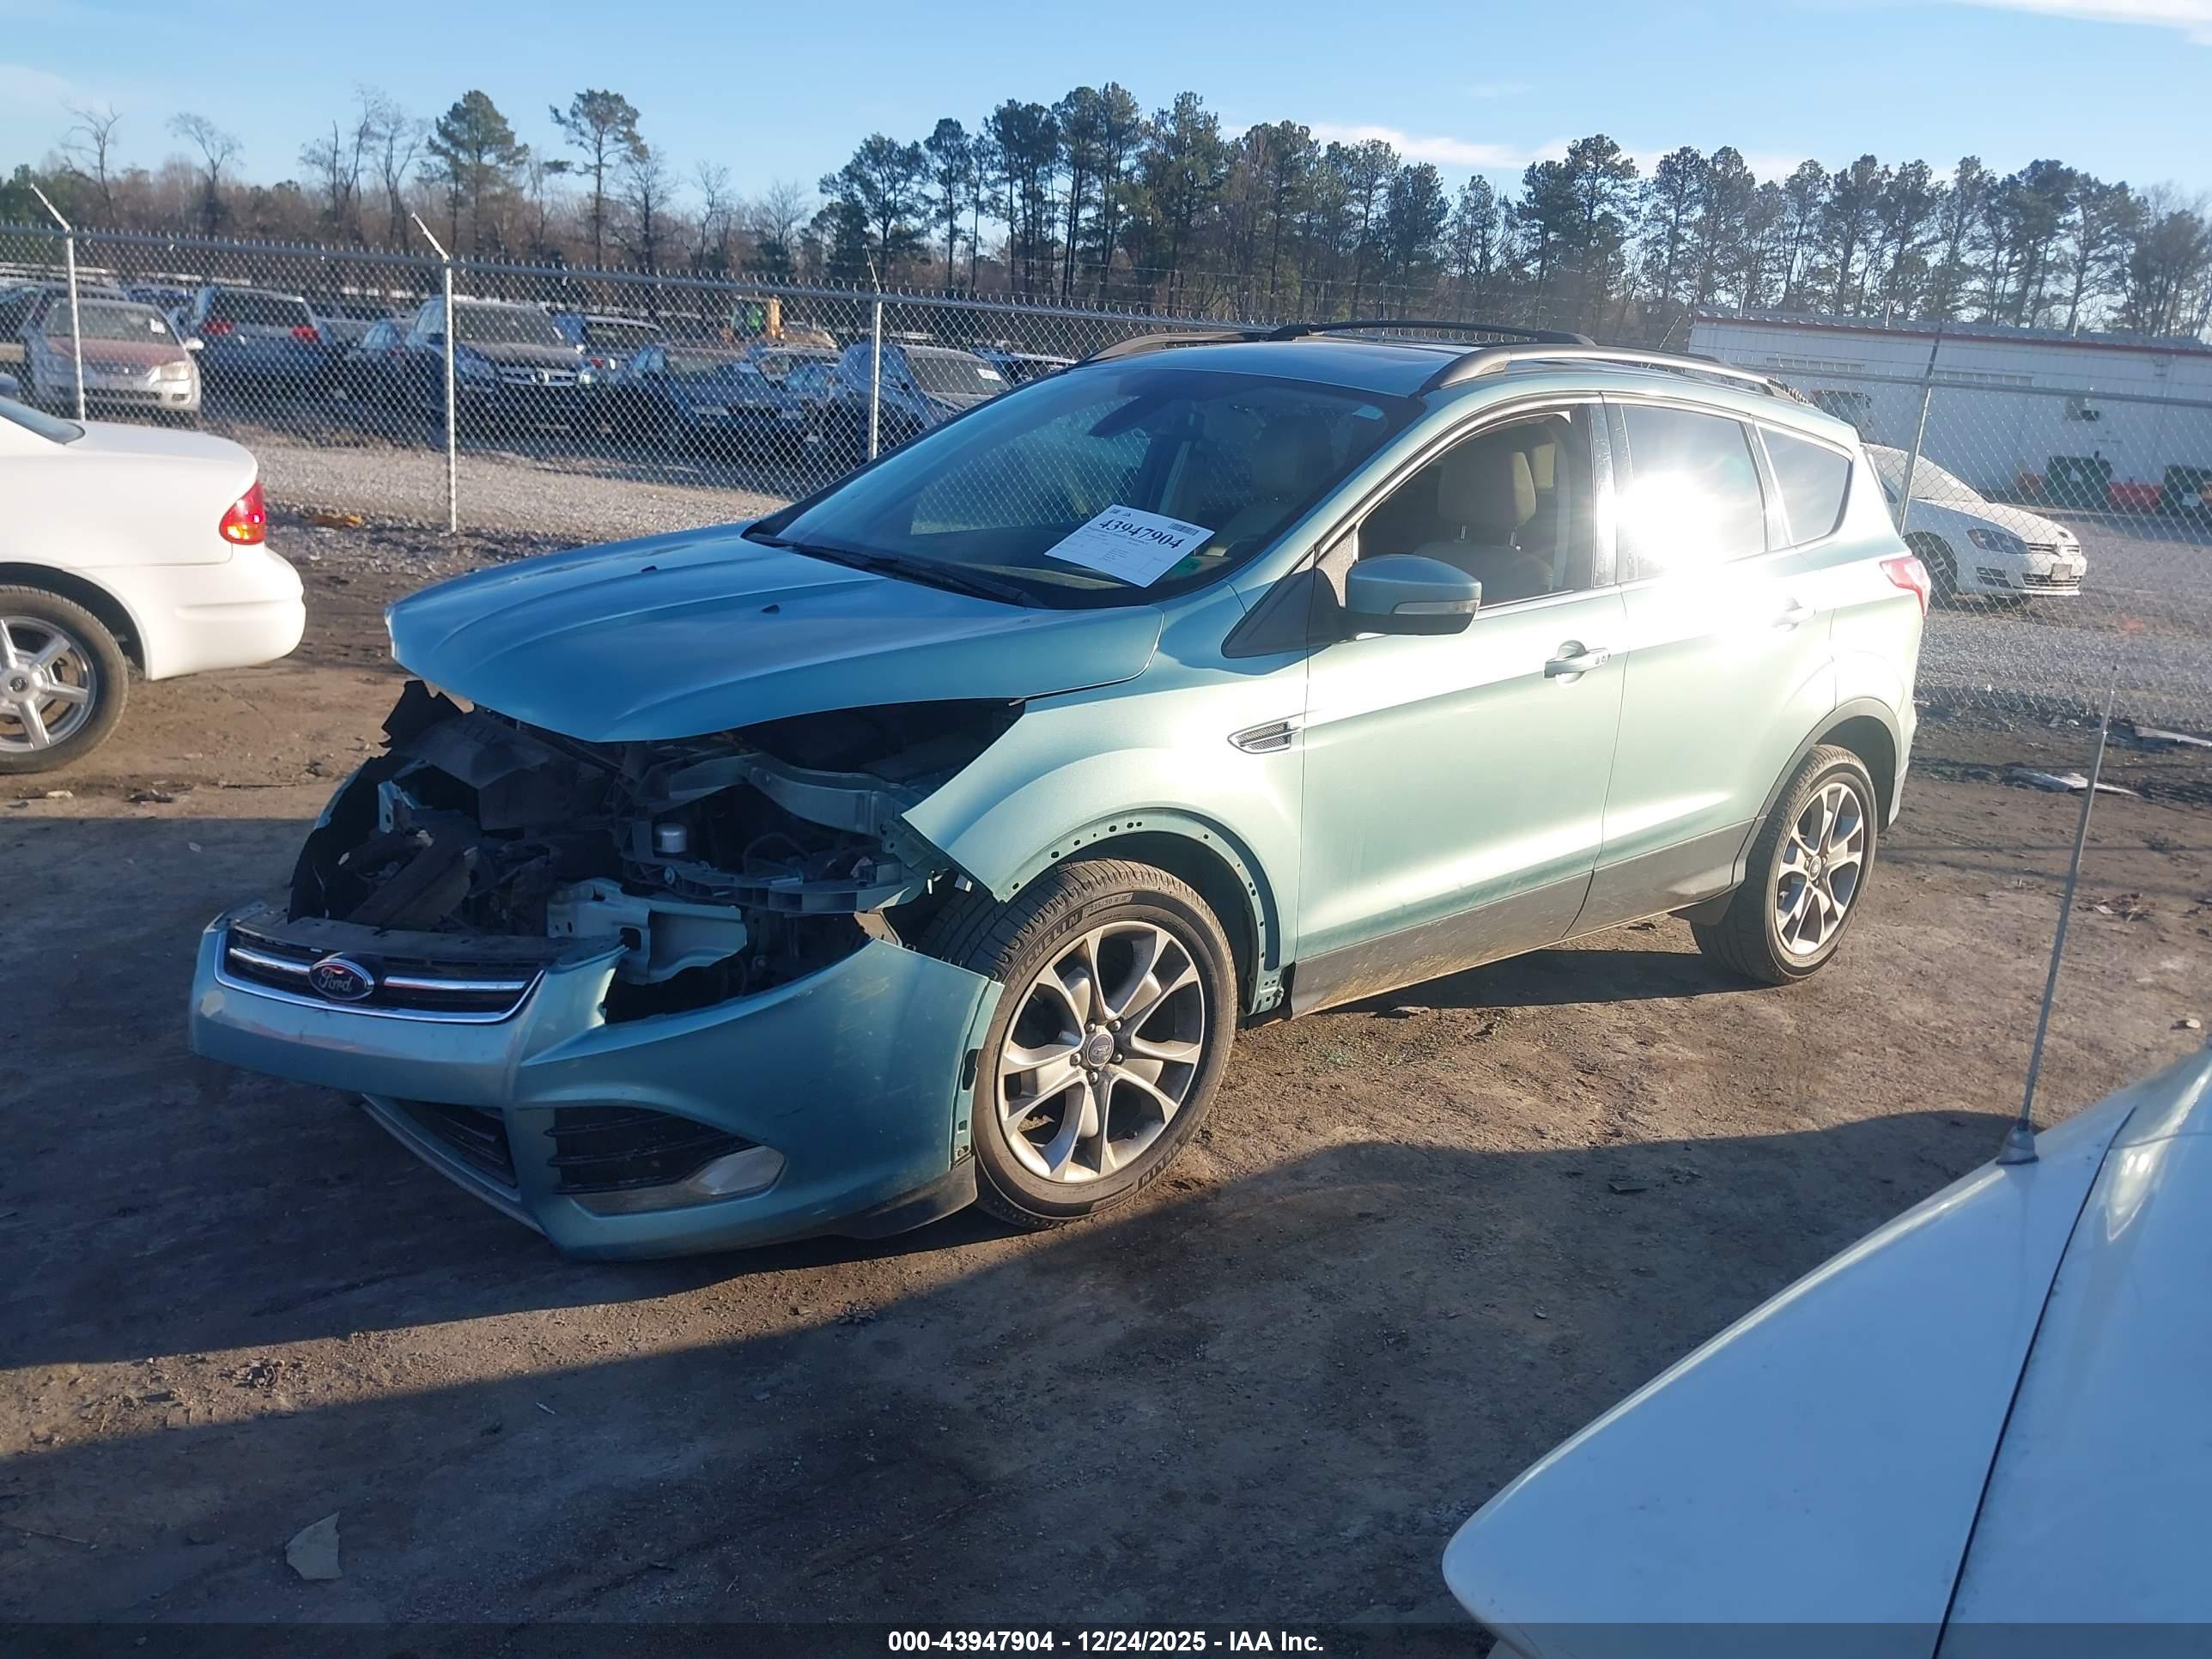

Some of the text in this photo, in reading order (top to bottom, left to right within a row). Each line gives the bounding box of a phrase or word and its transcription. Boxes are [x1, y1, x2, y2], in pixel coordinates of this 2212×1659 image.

[1098, 518, 1186, 550] 43947904
[1009, 912, 1080, 991] MICHELIN
[318, 966, 354, 993] Ford
